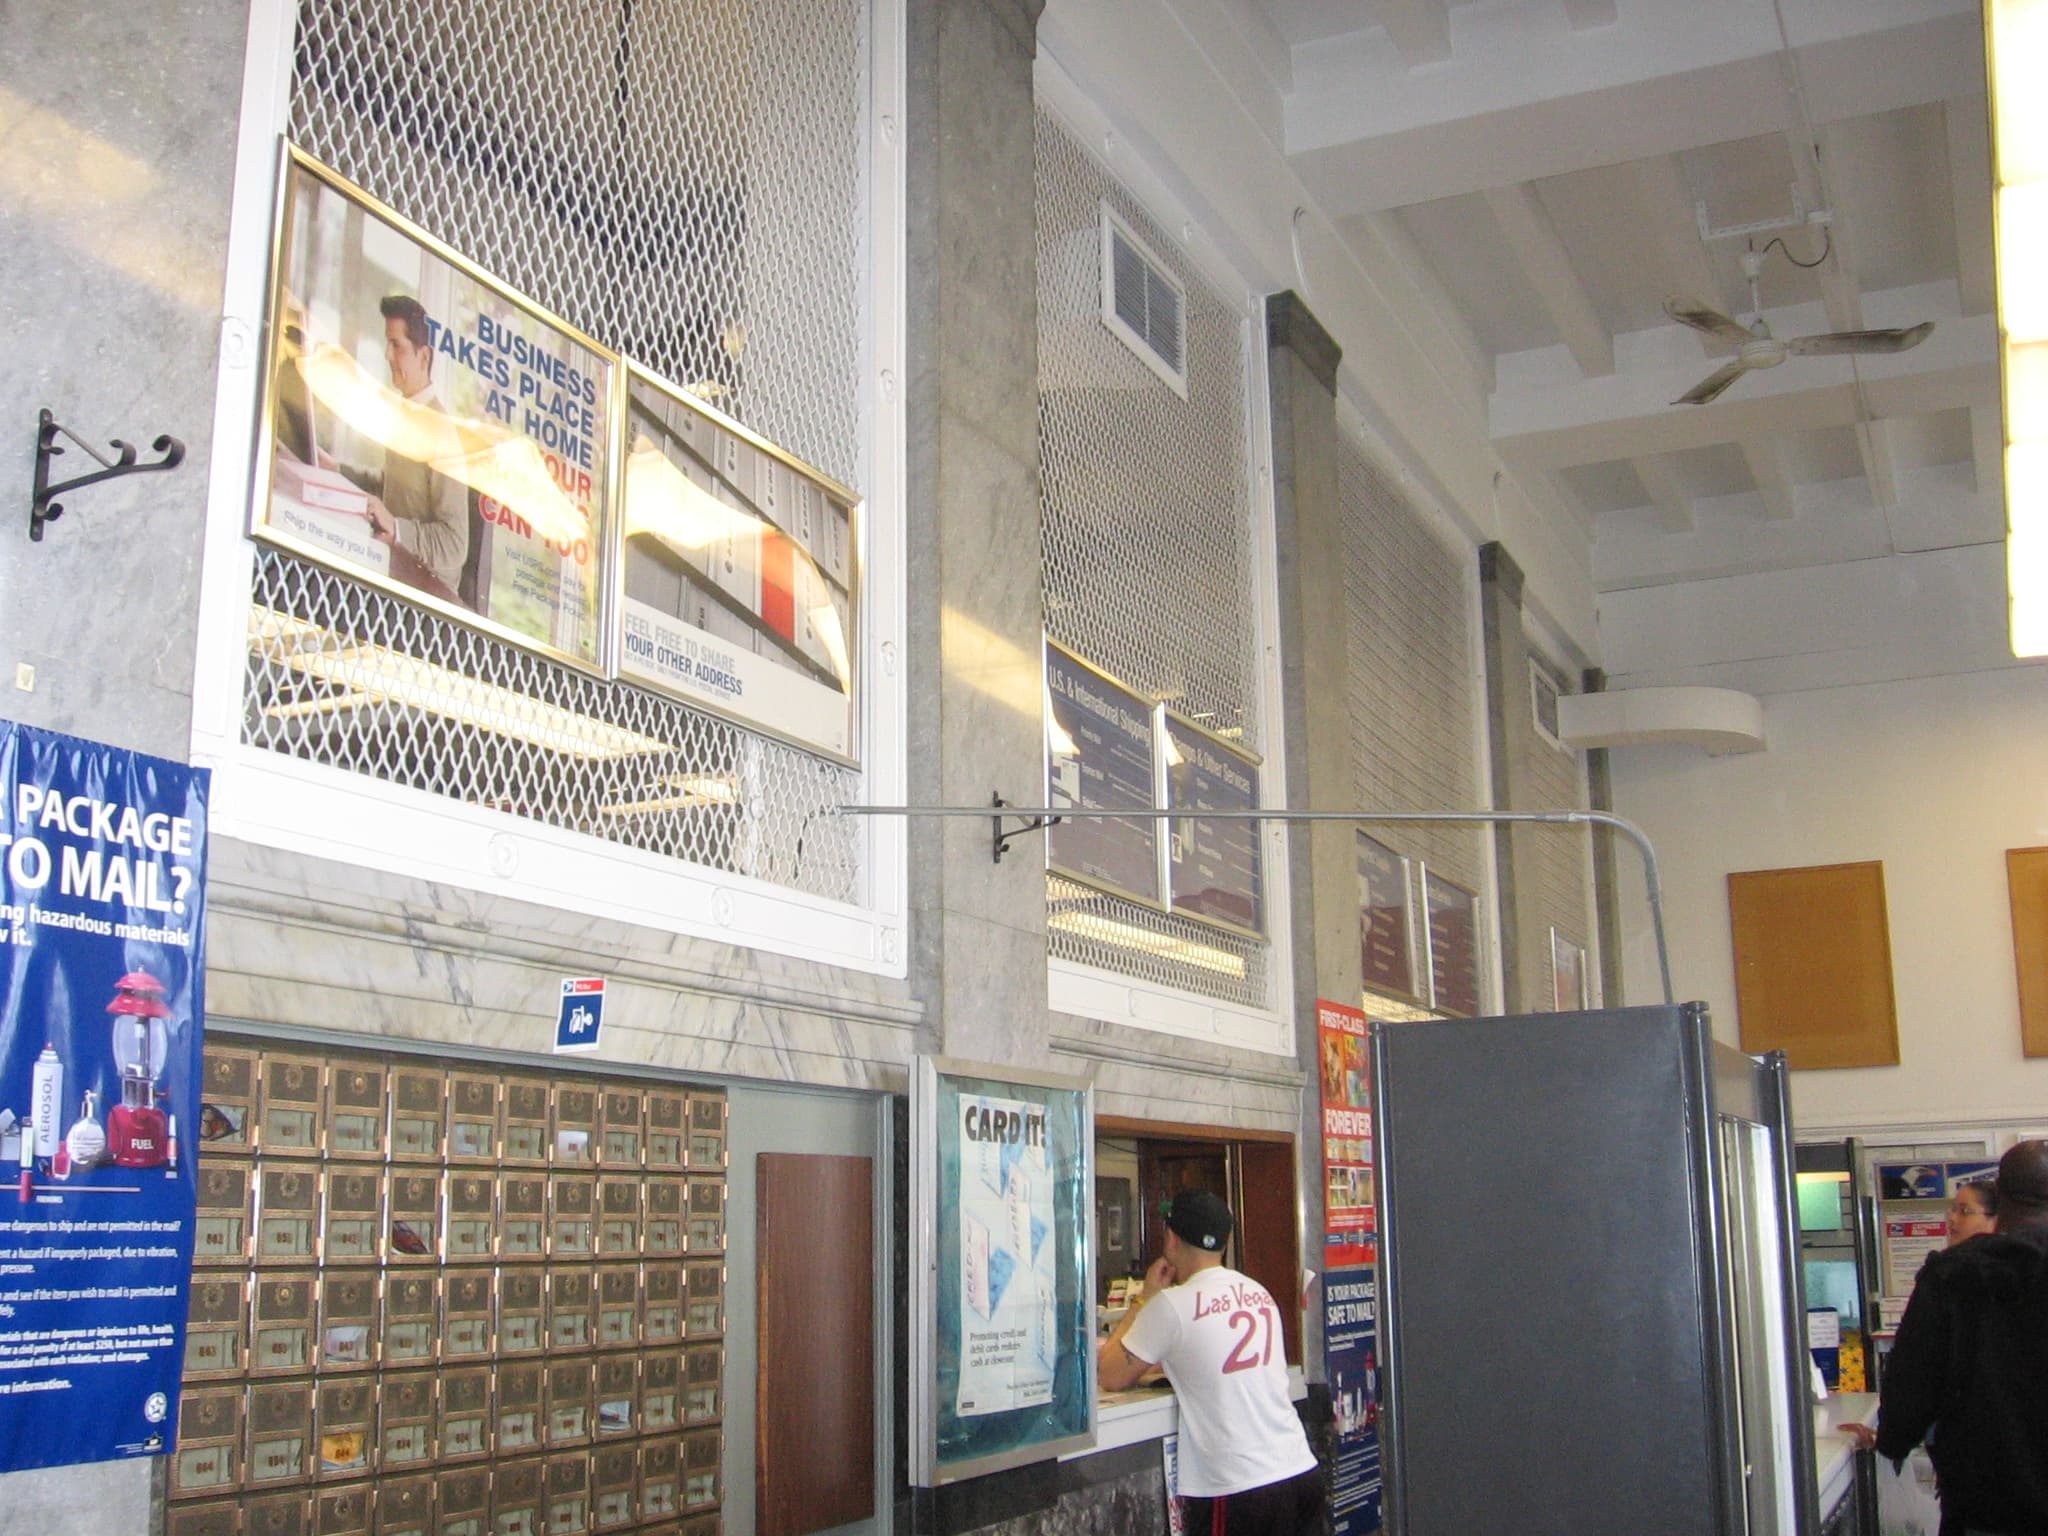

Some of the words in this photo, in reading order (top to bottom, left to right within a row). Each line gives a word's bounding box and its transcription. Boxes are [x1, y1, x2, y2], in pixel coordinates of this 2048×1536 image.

[424, 315, 510, 388] TAKES
[519, 372, 594, 438] PLACE
[478, 312, 596, 406] BUSINESS
[486, 389, 517, 424] AT
[525, 408, 593, 470] HOME
[541, 449, 592, 502] OUR
[479, 494, 532, 540] CAN
[625, 612, 653, 640] FEEL
[655, 625, 683, 652] FREE
[684, 637, 698, 660] TO
[701, 645, 737, 674] SHARE
[625, 631, 654, 659] YOUR
[657, 645, 692, 676] OTHER
[695, 663, 743, 696] ADDRESS
[1074, 680, 1119, 726] International
[19, 783, 192, 856] PACKAGE
[60, 845, 192, 914] MAIL?
[12, 926, 32, 946] it.
[30, 903, 112, 936] hazardous
[115, 924, 190, 947] materials
[1319, 1008, 1365, 1035] FIRST-CLASS
[40, 1075, 53, 1143] AEROSOL
[965, 1105, 1021, 1145] CARD
[1025, 1113, 1046, 1149] IT!
[1325, 1108, 1372, 1137] FOREVER
[131, 1138, 154, 1150] FUEL
[49, 1221, 57, 1231] to
[58, 1220, 73, 1234] ship
[109, 1220, 143, 1233] permitted
[1192, 1290, 1231, 1321] Las
[1328, 1304, 1346, 1326] SAFE
[1346, 1303, 1356, 1323] TO
[1222, 1307, 1273, 1374] 21
[12, 1378, 72, 1393] information.
